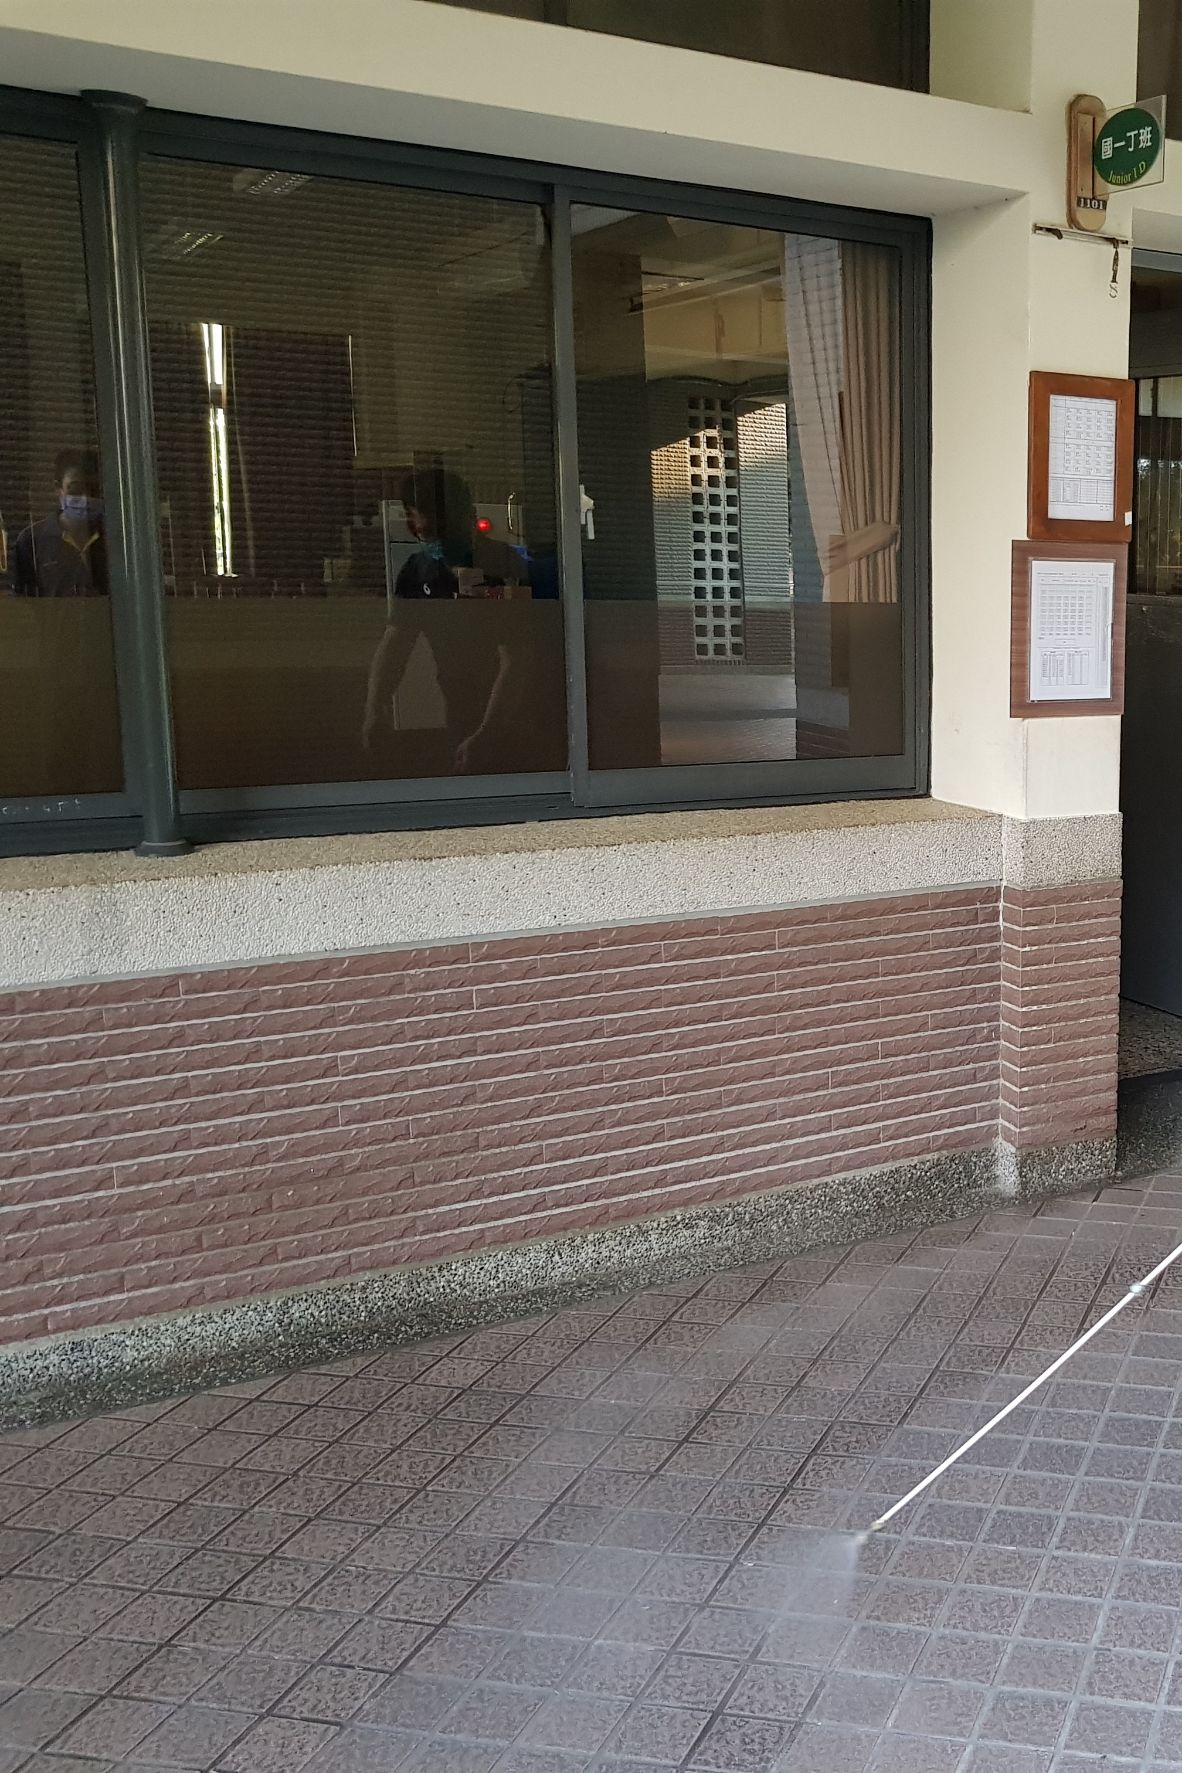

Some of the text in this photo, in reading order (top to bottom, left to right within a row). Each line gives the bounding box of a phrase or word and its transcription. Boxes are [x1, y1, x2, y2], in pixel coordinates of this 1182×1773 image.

[1101, 126, 1152, 160] 國一丁班
[1108, 170, 1132, 184] Junior
[1080, 198, 1104, 210] 1101
